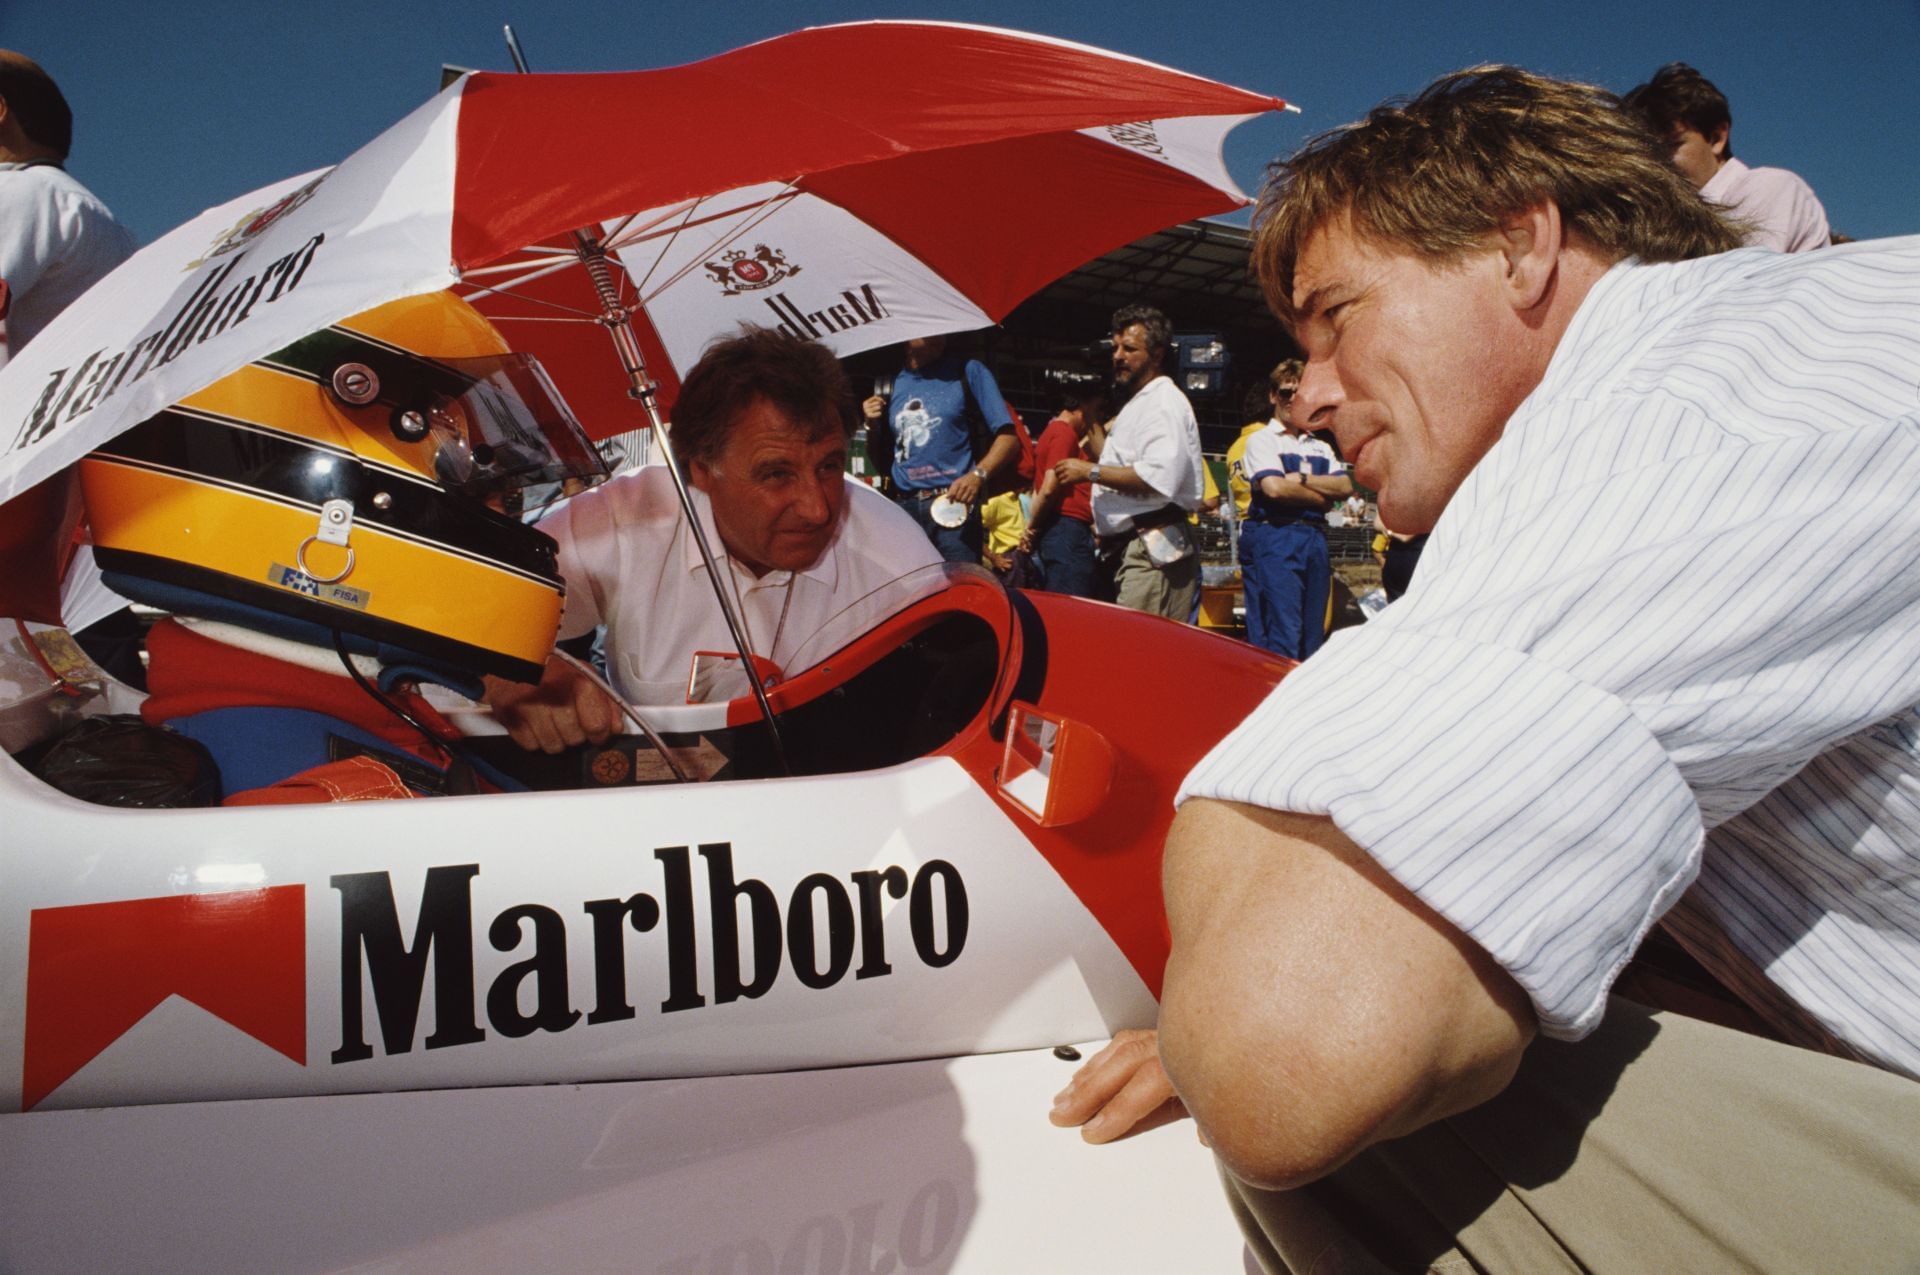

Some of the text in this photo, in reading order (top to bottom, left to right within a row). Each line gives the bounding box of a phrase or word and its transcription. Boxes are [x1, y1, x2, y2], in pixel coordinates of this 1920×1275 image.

[4, 232, 325, 456] Marlboro
[333, 588, 359, 603] FISA
[330, 842, 970, 1064] Marlboro
